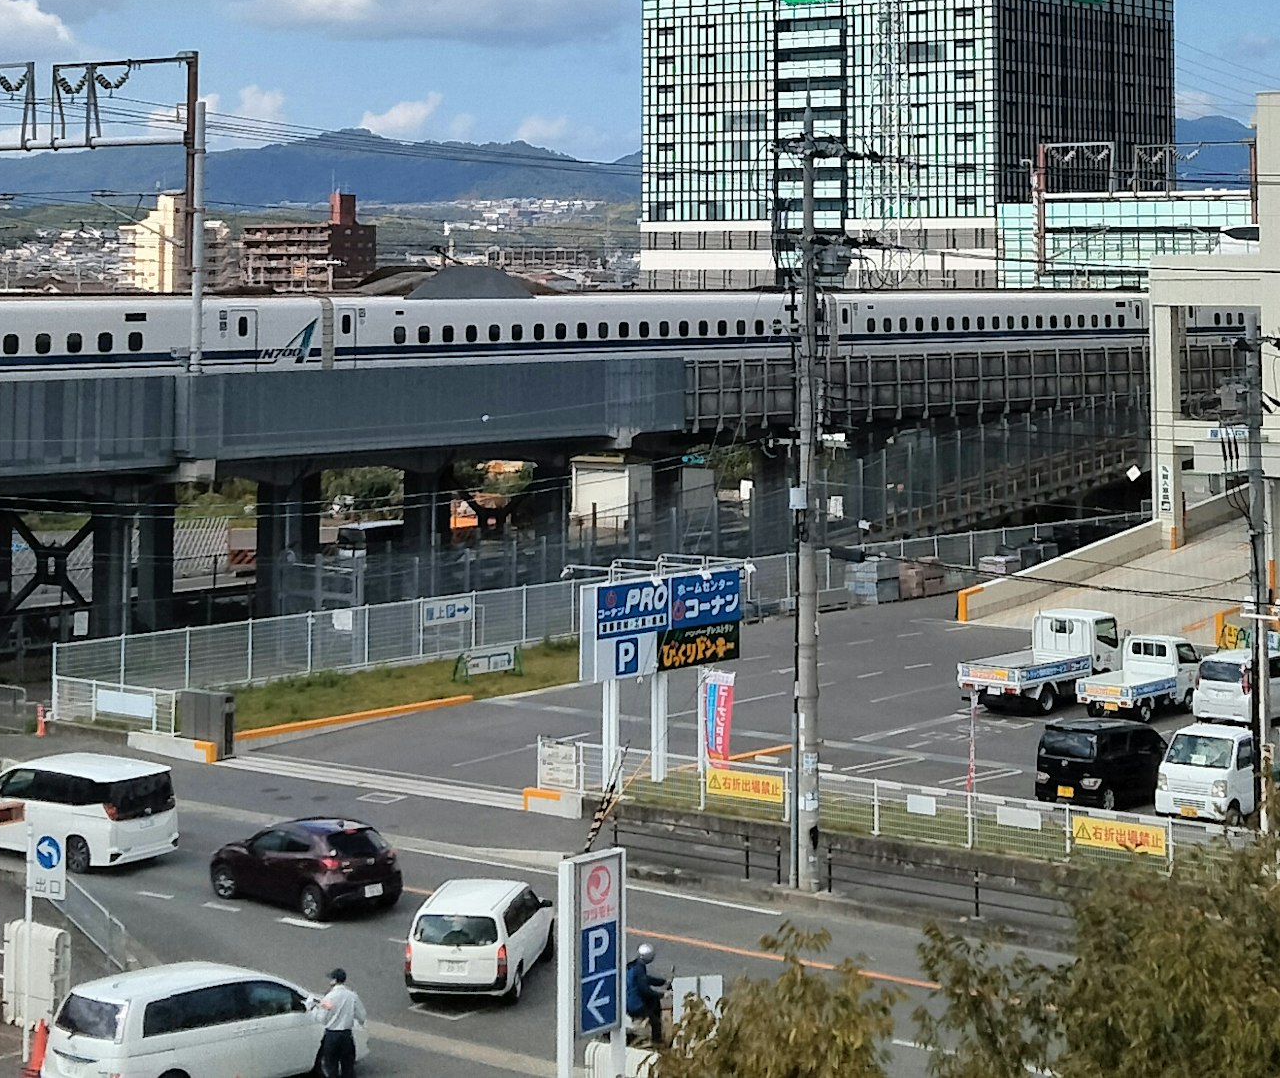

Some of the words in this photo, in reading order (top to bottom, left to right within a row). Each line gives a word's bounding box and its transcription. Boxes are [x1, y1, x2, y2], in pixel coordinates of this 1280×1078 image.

[625, 583, 668, 614] PRO
[677, 578, 734, 595] ホームセンター
[597, 606, 625, 620] コーナン
[685, 594, 739, 619] コーナン
[619, 641, 635, 672] P
[663, 636, 735, 667] びっくりドンキー
[722, 776, 780, 796] 右折出場禁止
[1092, 826, 1163, 849] 右折出場禁止
[35, 877, 60, 893] 出口
[588, 928, 610, 973] P
